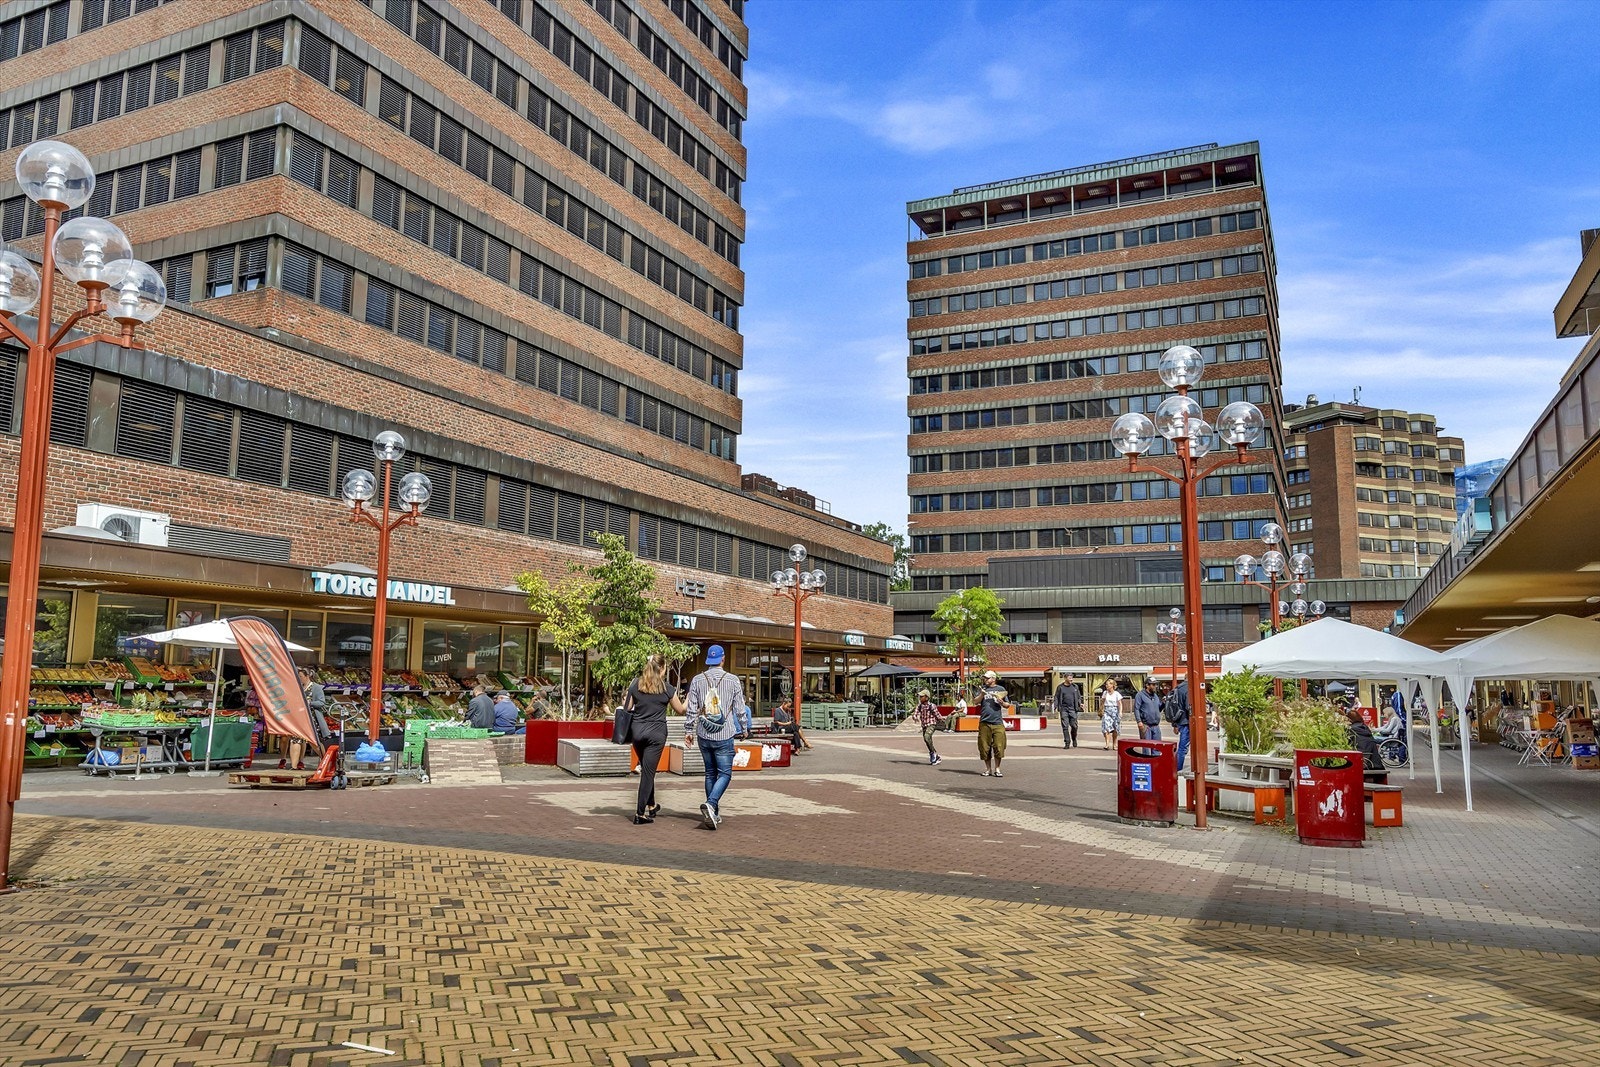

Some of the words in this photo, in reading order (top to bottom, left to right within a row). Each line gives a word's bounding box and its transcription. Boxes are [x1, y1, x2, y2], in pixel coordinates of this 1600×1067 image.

[675, 576, 706, 599] H22
[673, 614, 697, 630] TSV
[845, 634, 866, 647] GRILL
[1099, 654, 1120, 662] BAR
[1181, 653, 1220, 662] BERI
